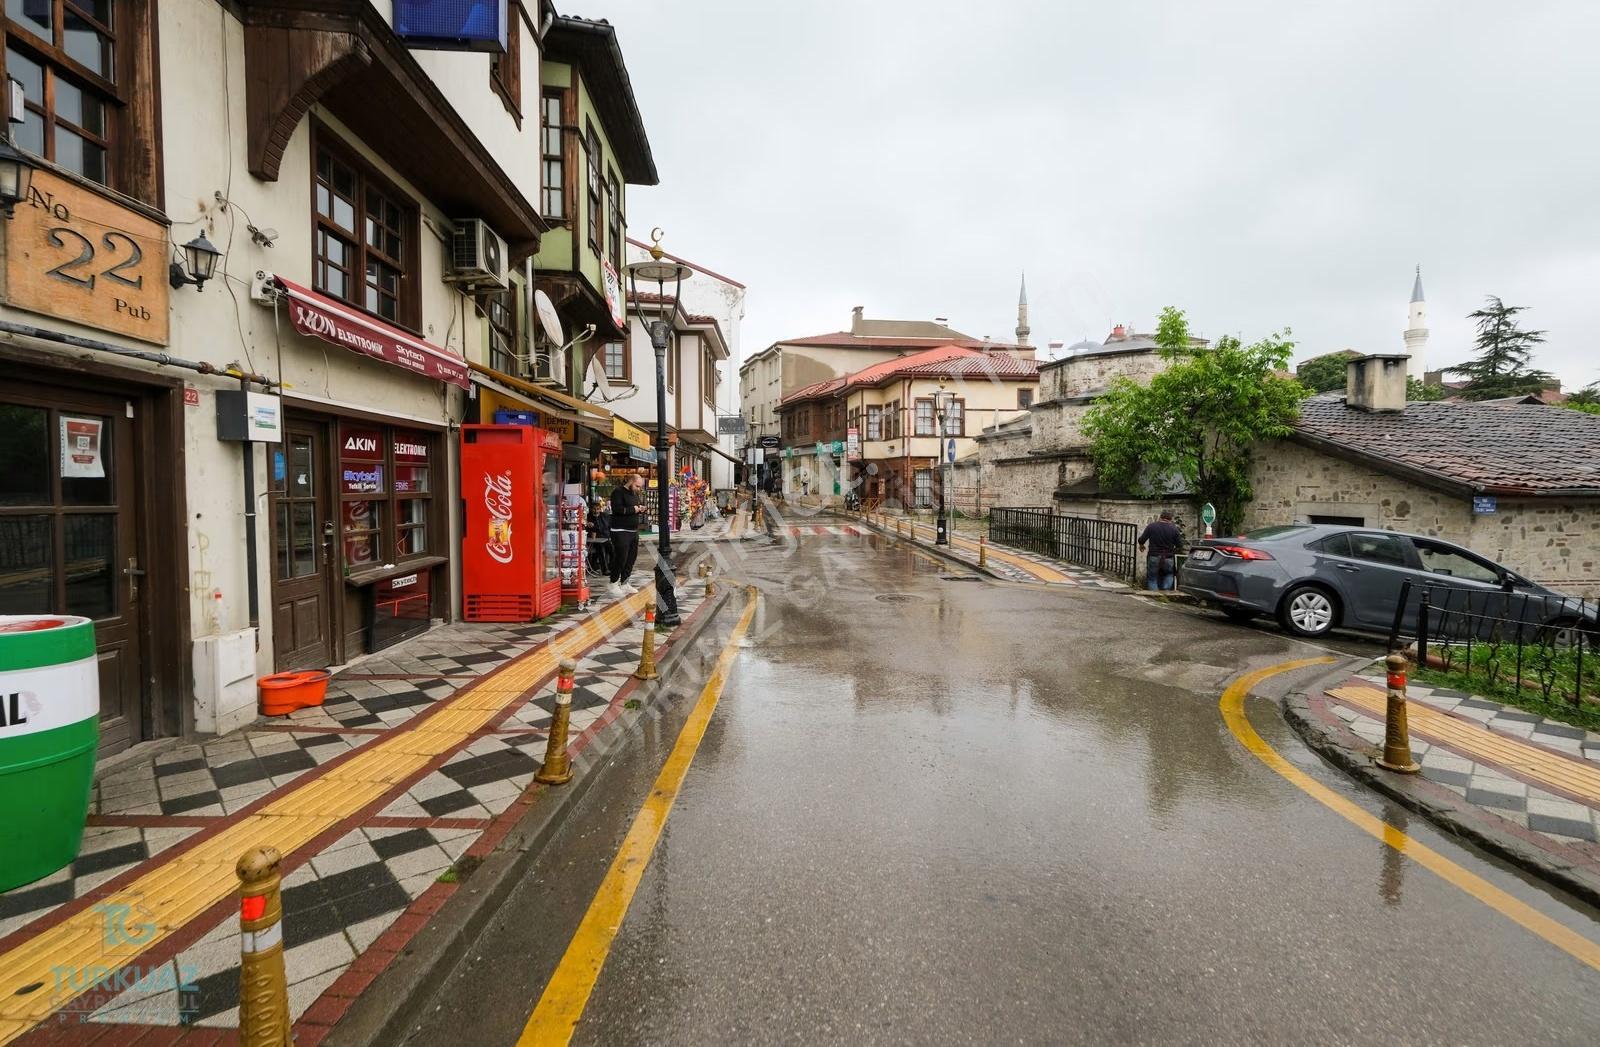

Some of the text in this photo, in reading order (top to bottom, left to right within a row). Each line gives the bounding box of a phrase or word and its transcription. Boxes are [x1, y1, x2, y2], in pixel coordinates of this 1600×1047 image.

[29, 185, 71, 223] No
[46, 227, 143, 291] 22
[113, 297, 151, 321] Pub
[395, 344, 425, 363] Skytech
[184, 391, 197, 402] 22
[344, 436, 376, 452] AKIN
[484, 470, 513, 564] Co-Cola
